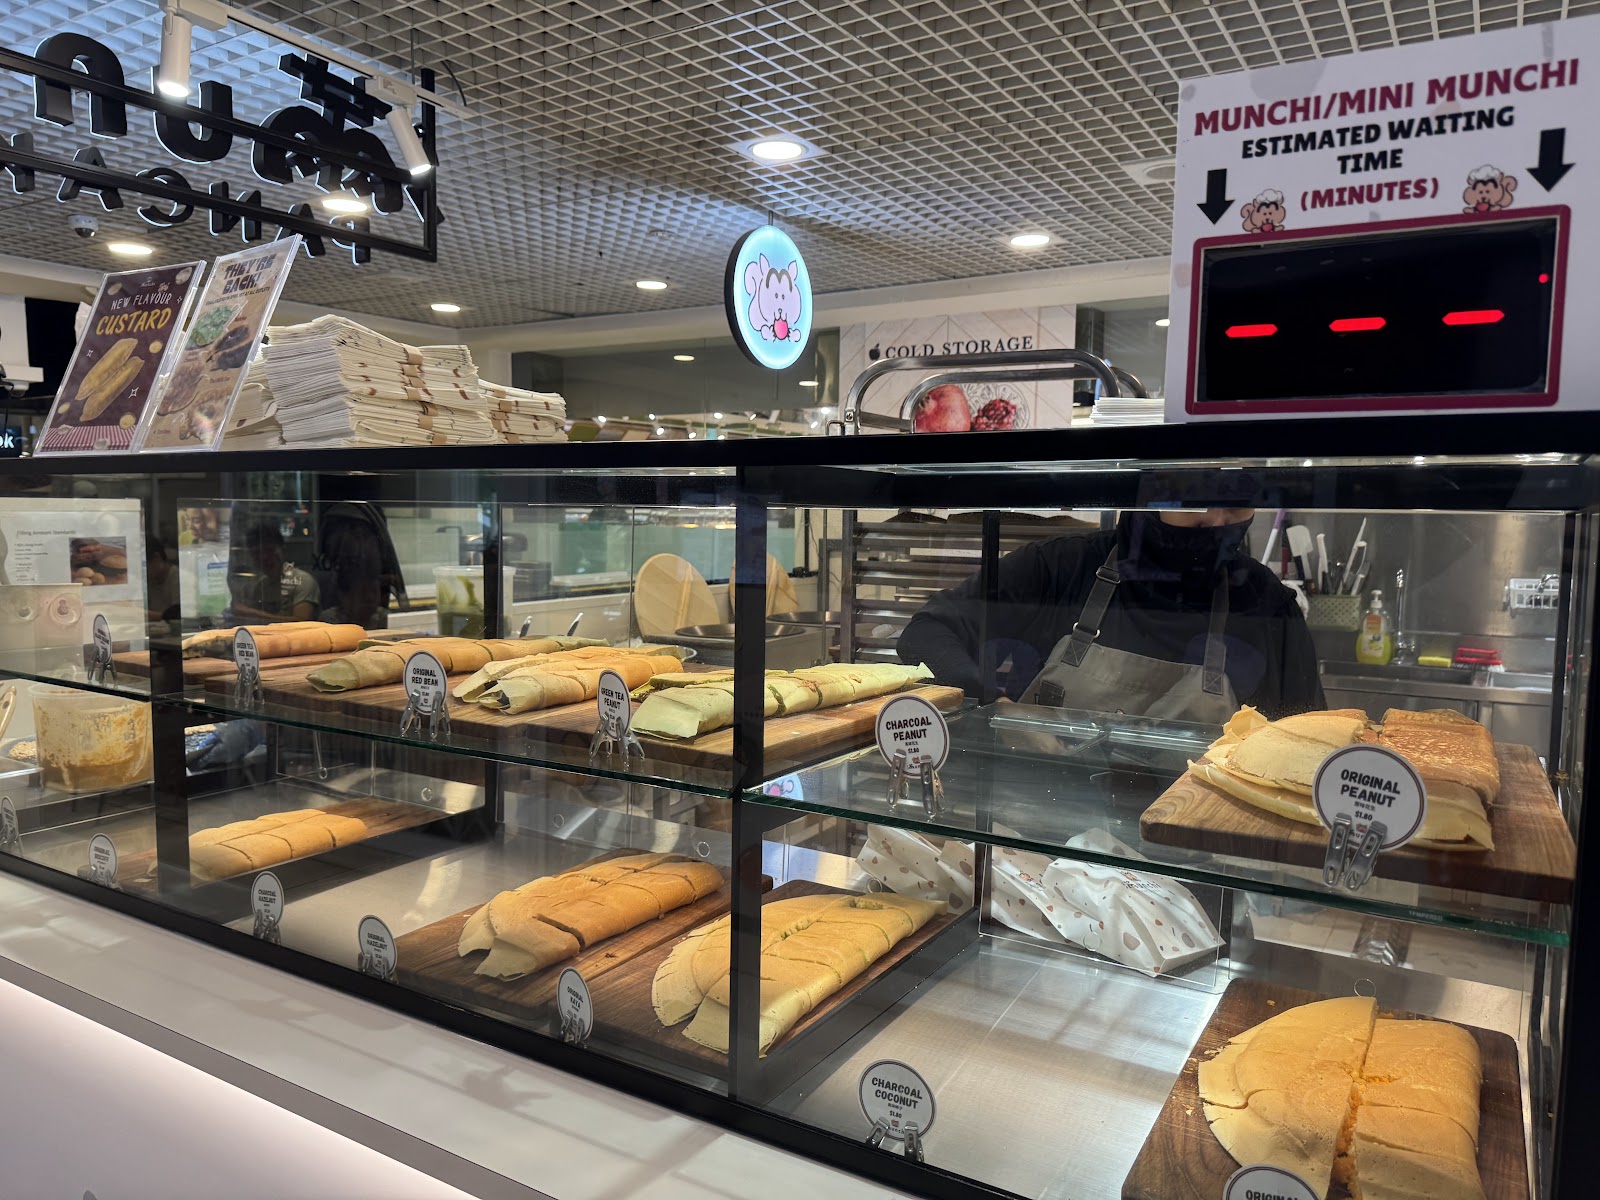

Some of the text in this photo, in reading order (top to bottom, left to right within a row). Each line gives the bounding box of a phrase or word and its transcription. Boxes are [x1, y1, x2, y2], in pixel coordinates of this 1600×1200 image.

[1194, 58, 1579, 136] MUNCHI/MINI MUNCHI
[1241, 106, 1515, 159] ESTIMATED WAITING
[1337, 149, 1403, 175] TIME
[1300, 177, 1439, 212] (MINUTES)
[224, 253, 277, 280] THEY'RE
[222, 272, 262, 295] BACK!
[111, 291, 173, 310] NEW FLAVOUR
[96, 308, 172, 335] CUSTARD
[886, 335, 1034, 358] COLD STORAGE
[411, 676, 439, 687] RED BEAN
[412, 667, 437, 678] ORIGINAL
[601, 687, 625, 701] GREEN TEA
[604, 697, 621, 710] PEANUT
[885, 716, 932, 731] CHARCOAL
[893, 728, 927, 742] PEANUT
[1340, 768, 1401, 795] ORIGINAL
[1340, 784, 1396, 808] PEANUT
[1354, 810, 1373, 821] $1.80
[366, 938, 388, 950] HAZELNUT
[367, 932, 386, 943] ORIGINAL
[871, 1077, 923, 1100] CHARCOAL
[875, 1089, 919, 1109] COCONUT
